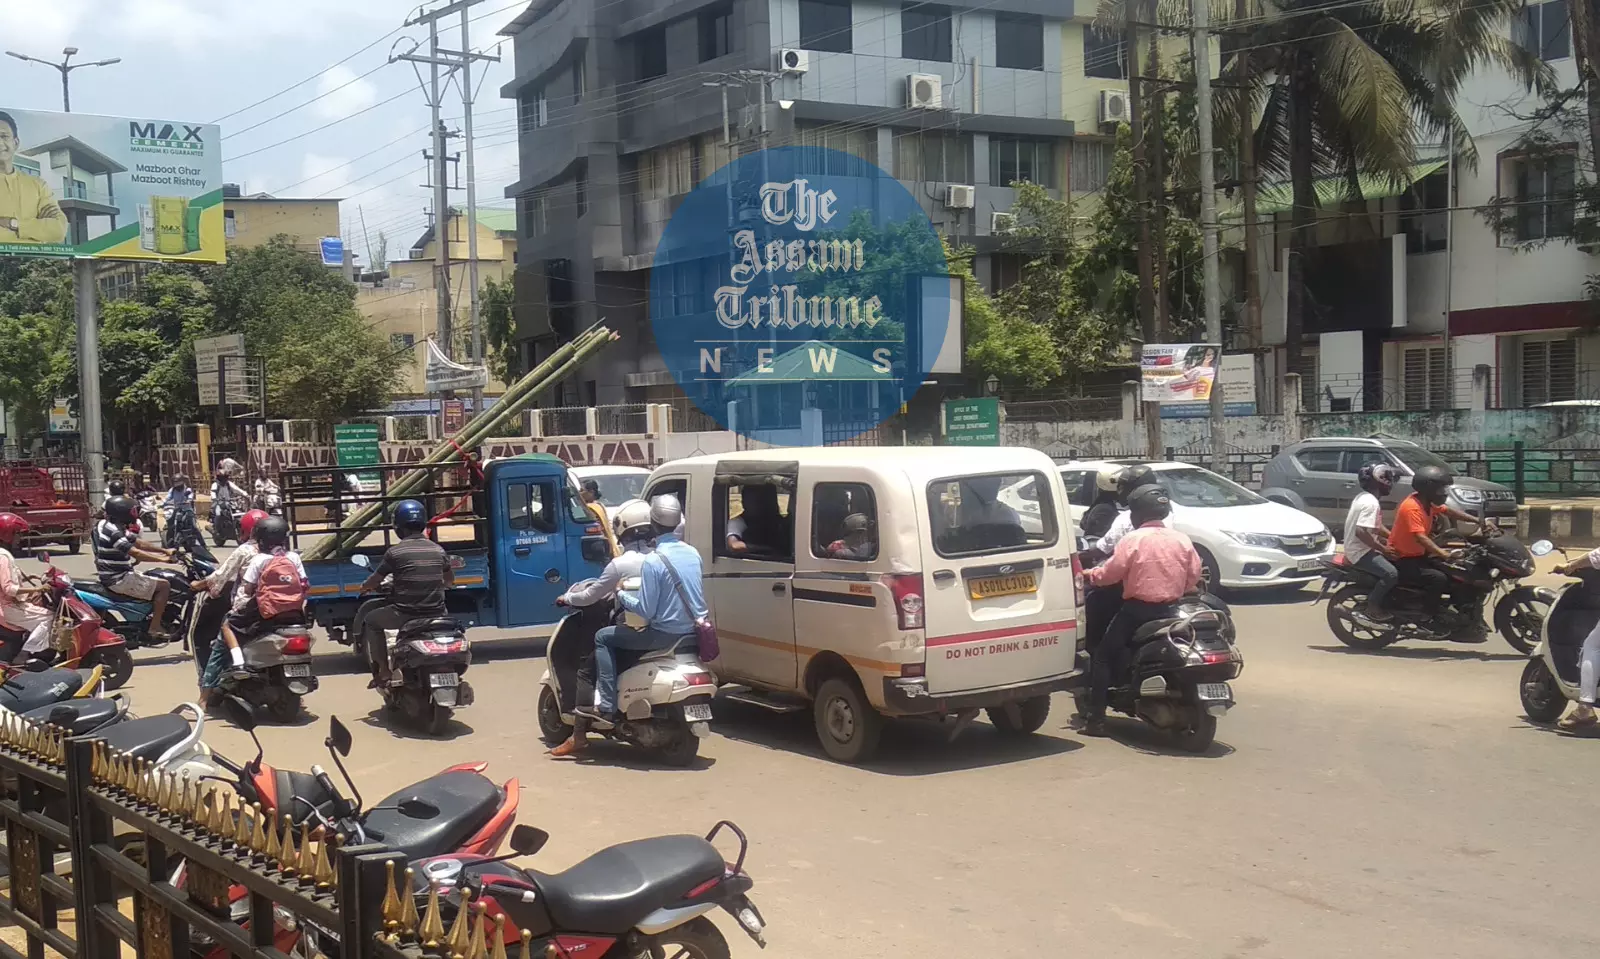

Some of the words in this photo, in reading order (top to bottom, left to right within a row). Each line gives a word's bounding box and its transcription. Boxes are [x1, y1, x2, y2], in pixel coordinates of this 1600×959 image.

[130, 121, 204, 142] MAX
[132, 139, 204, 150] CEMENT
[136, 164, 176, 174] Mazboot
[178, 166, 201, 176] Ghar
[131, 174, 172, 184] Mazboot
[173, 178, 206, 188] Rishtey
[978, 576, 1034, 596] AS01LC3103
[946, 650, 961, 660] DO
[964, 646, 986, 658] NOT
[989, 642, 1020, 654] DRINK
[1022, 640, 1030, 650] &
[1032, 636, 1059, 648] DRIVE
